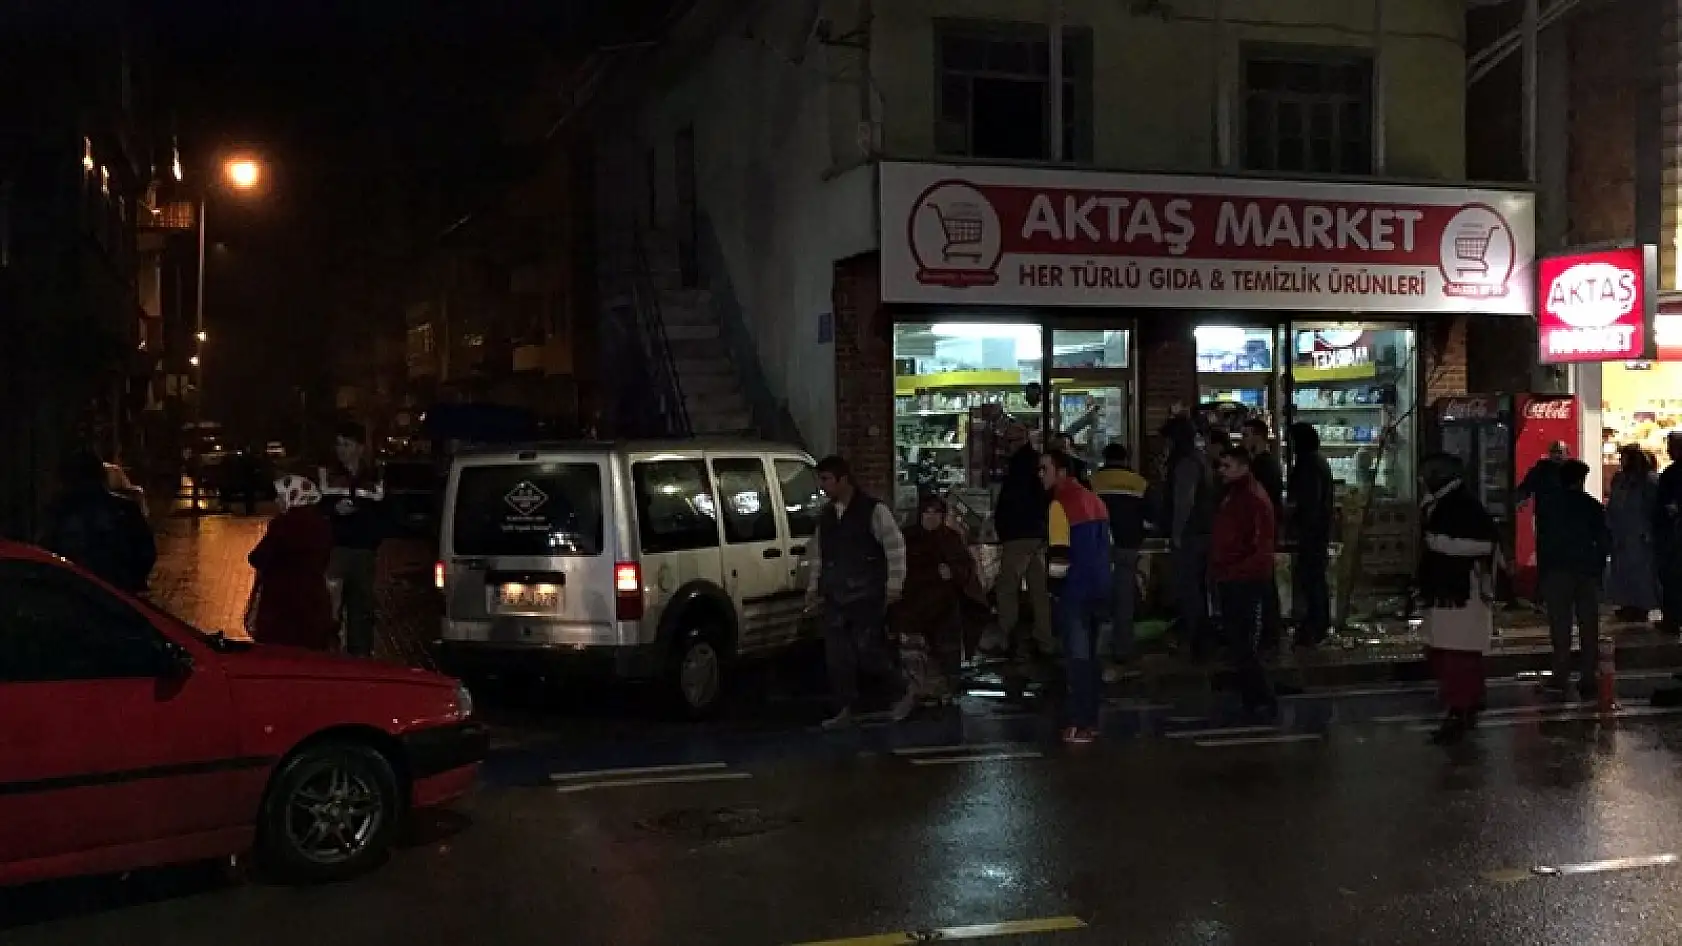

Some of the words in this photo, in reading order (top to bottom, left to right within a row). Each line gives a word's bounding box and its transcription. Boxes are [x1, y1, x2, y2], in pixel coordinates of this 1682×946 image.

[1022, 193, 1195, 254] AKTAŞ
[1214, 201, 1424, 252] MARKET
[1019, 264, 1063, 287] HER
[1071, 260, 1140, 289] TÜRLÜ
[1149, 267, 1203, 292] GIDA
[1211, 269, 1226, 292] &
[1231, 265, 1321, 292] TEMİZLİK
[1328, 267, 1426, 295] ÜRÜNLERİ
